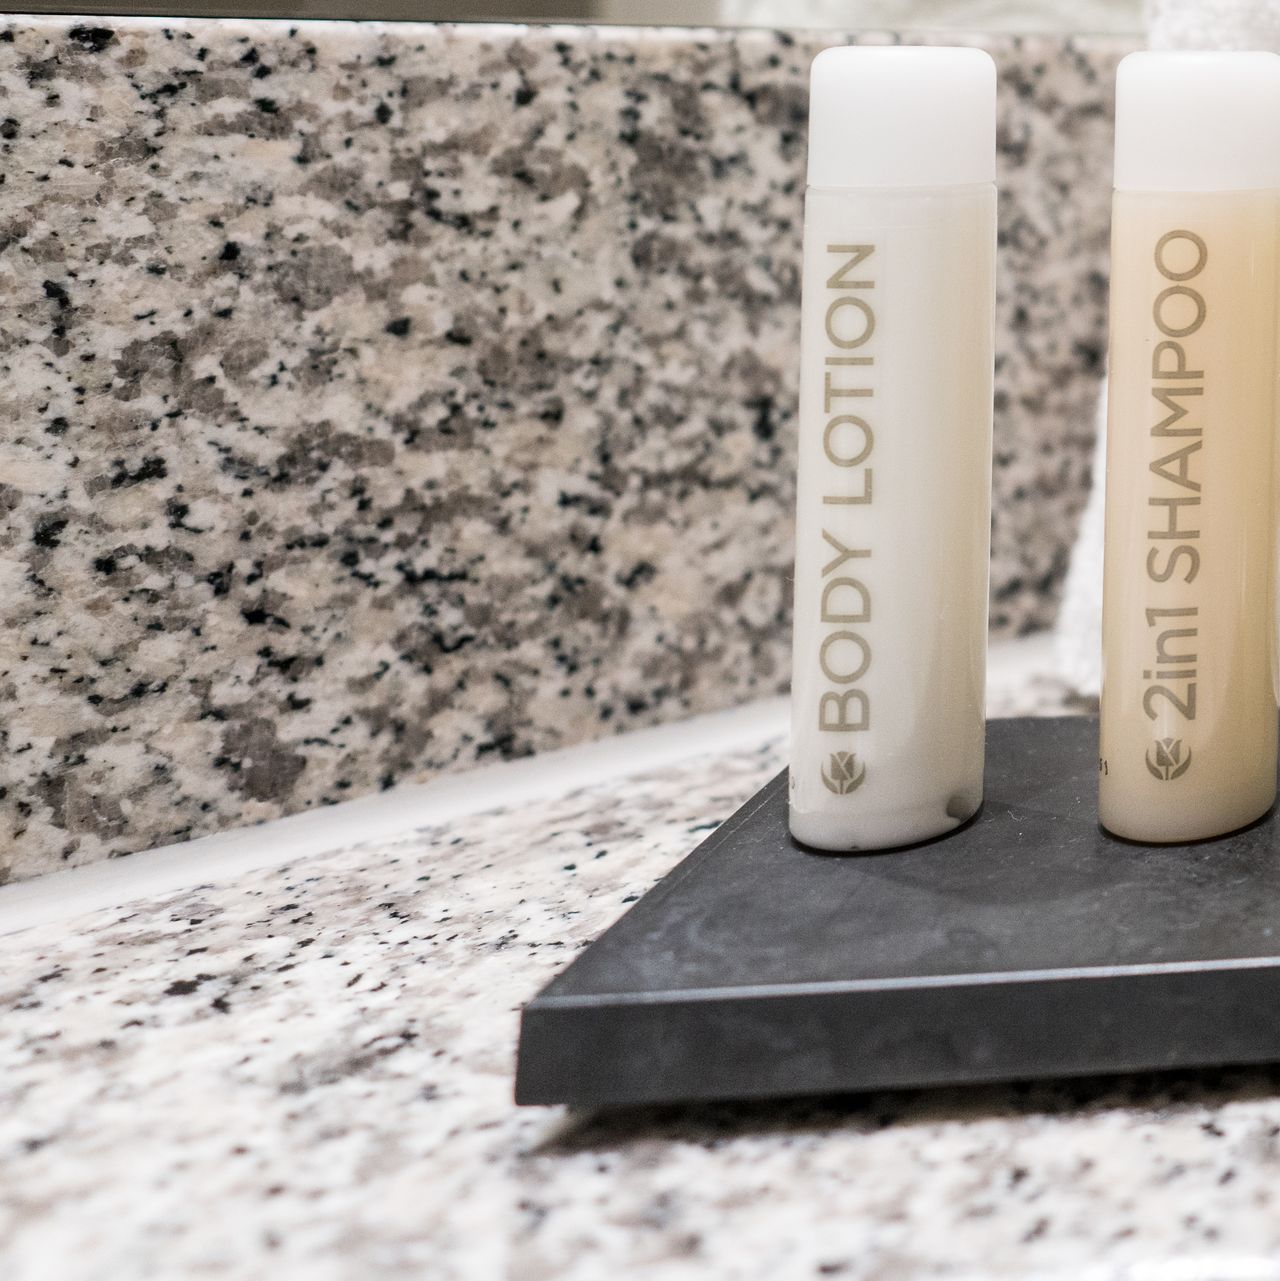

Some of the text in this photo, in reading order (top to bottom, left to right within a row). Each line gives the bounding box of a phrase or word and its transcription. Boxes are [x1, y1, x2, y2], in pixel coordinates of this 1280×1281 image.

[819, 244, 877, 733] BODY LOTION
[1142, 229, 1209, 722] 2in1 SHAMPOO
